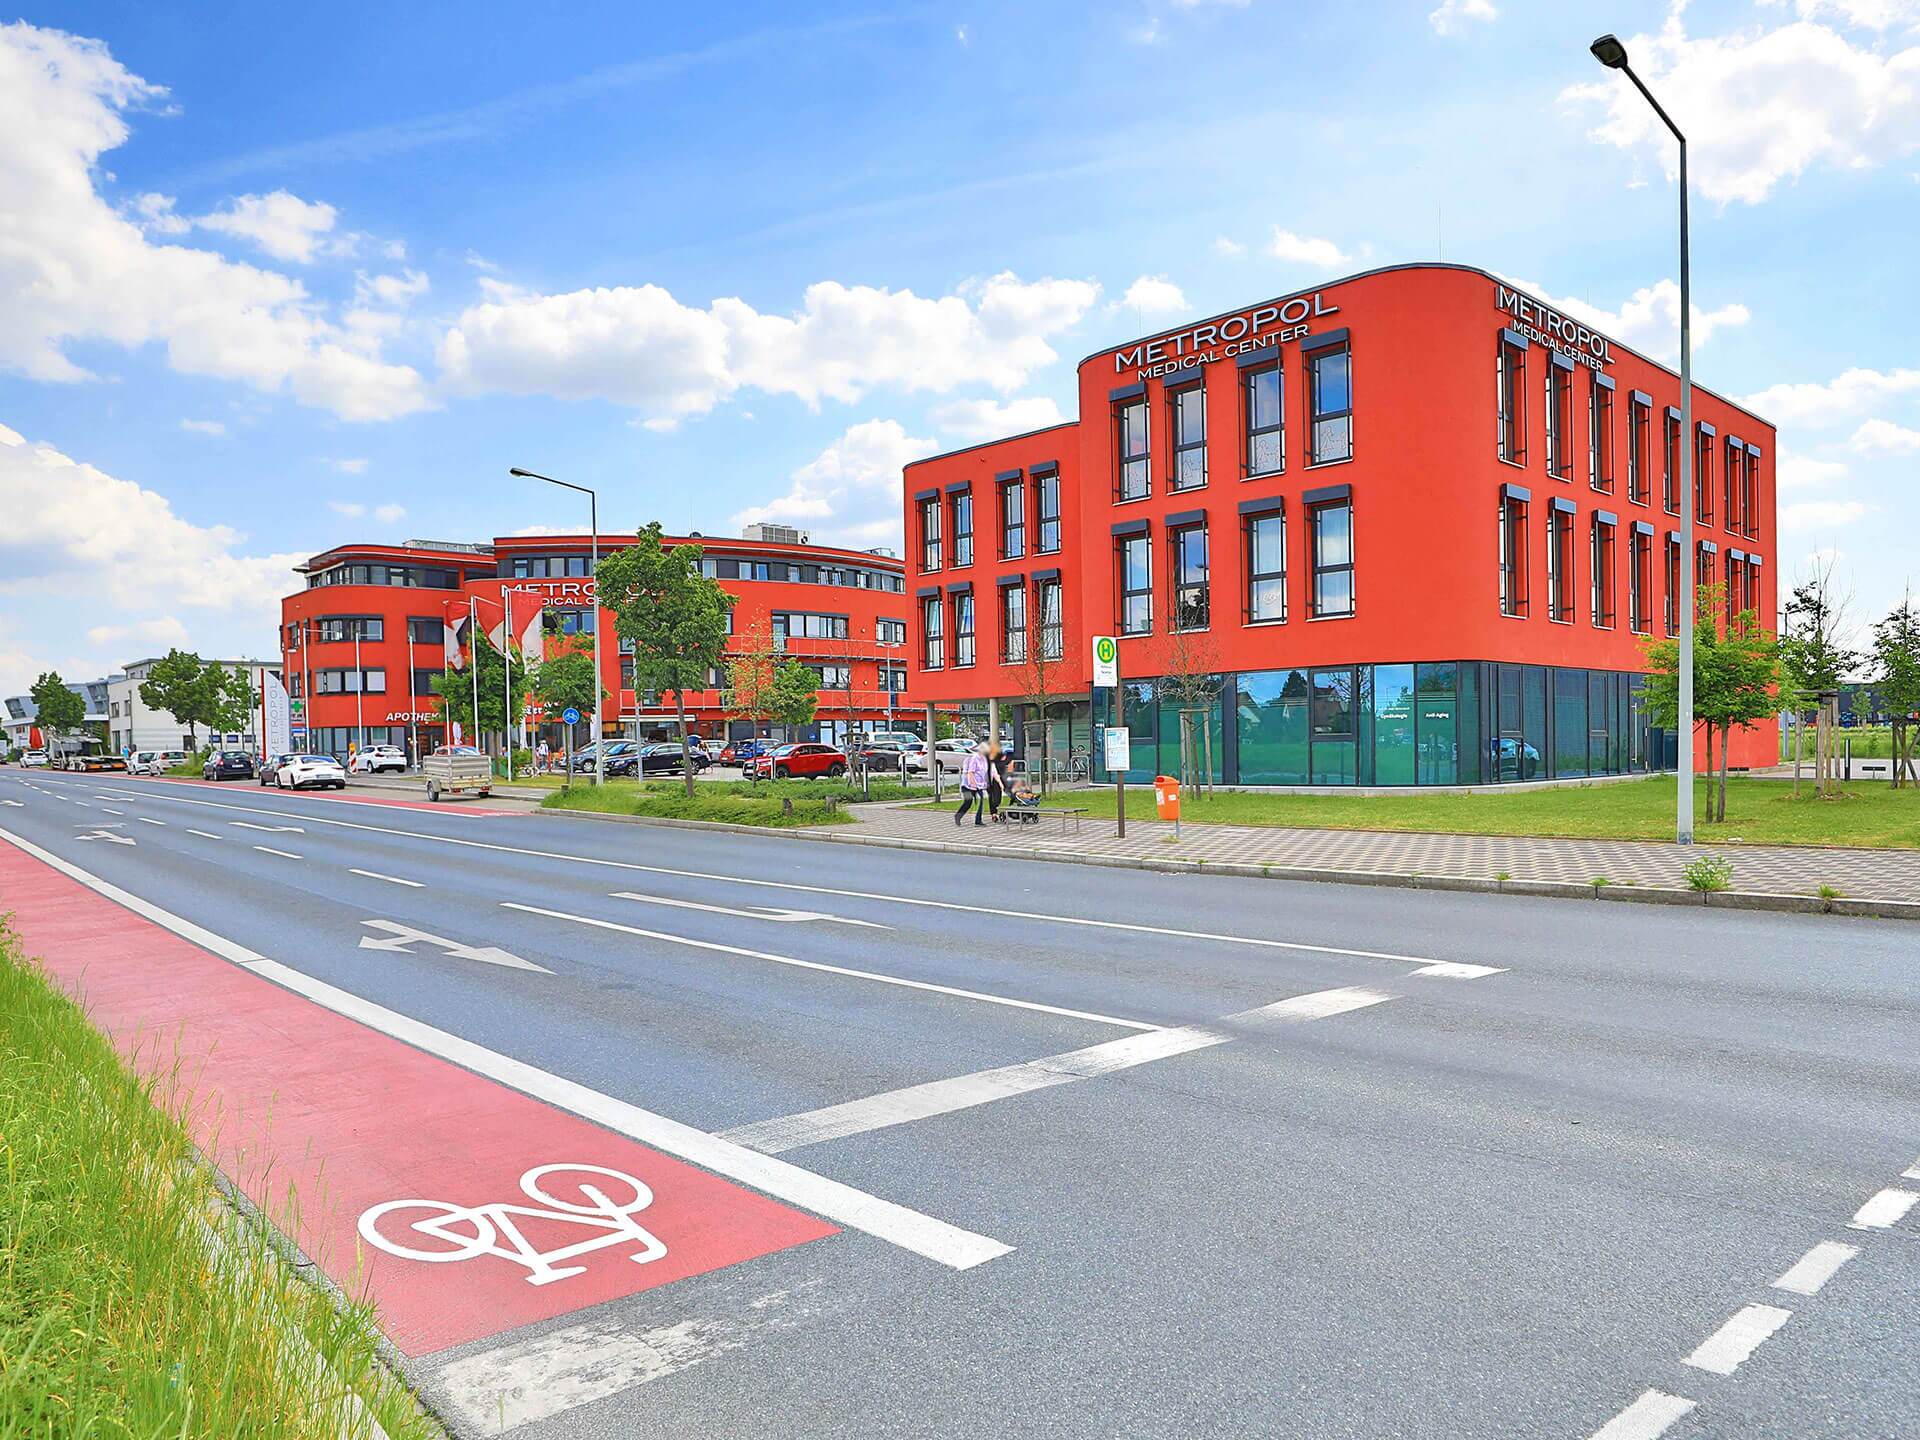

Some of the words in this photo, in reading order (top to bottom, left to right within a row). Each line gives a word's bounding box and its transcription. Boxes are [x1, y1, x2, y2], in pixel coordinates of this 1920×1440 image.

[1115, 293, 1339, 373] METROPOL
[1137, 350, 1220, 382] MEDICAL
[1224, 324, 1309, 357] CENTER
[1497, 285, 1615, 364] METROPOL
[1513, 319, 1562, 354] MEDICAL
[1563, 344, 1604, 373] CENTER
